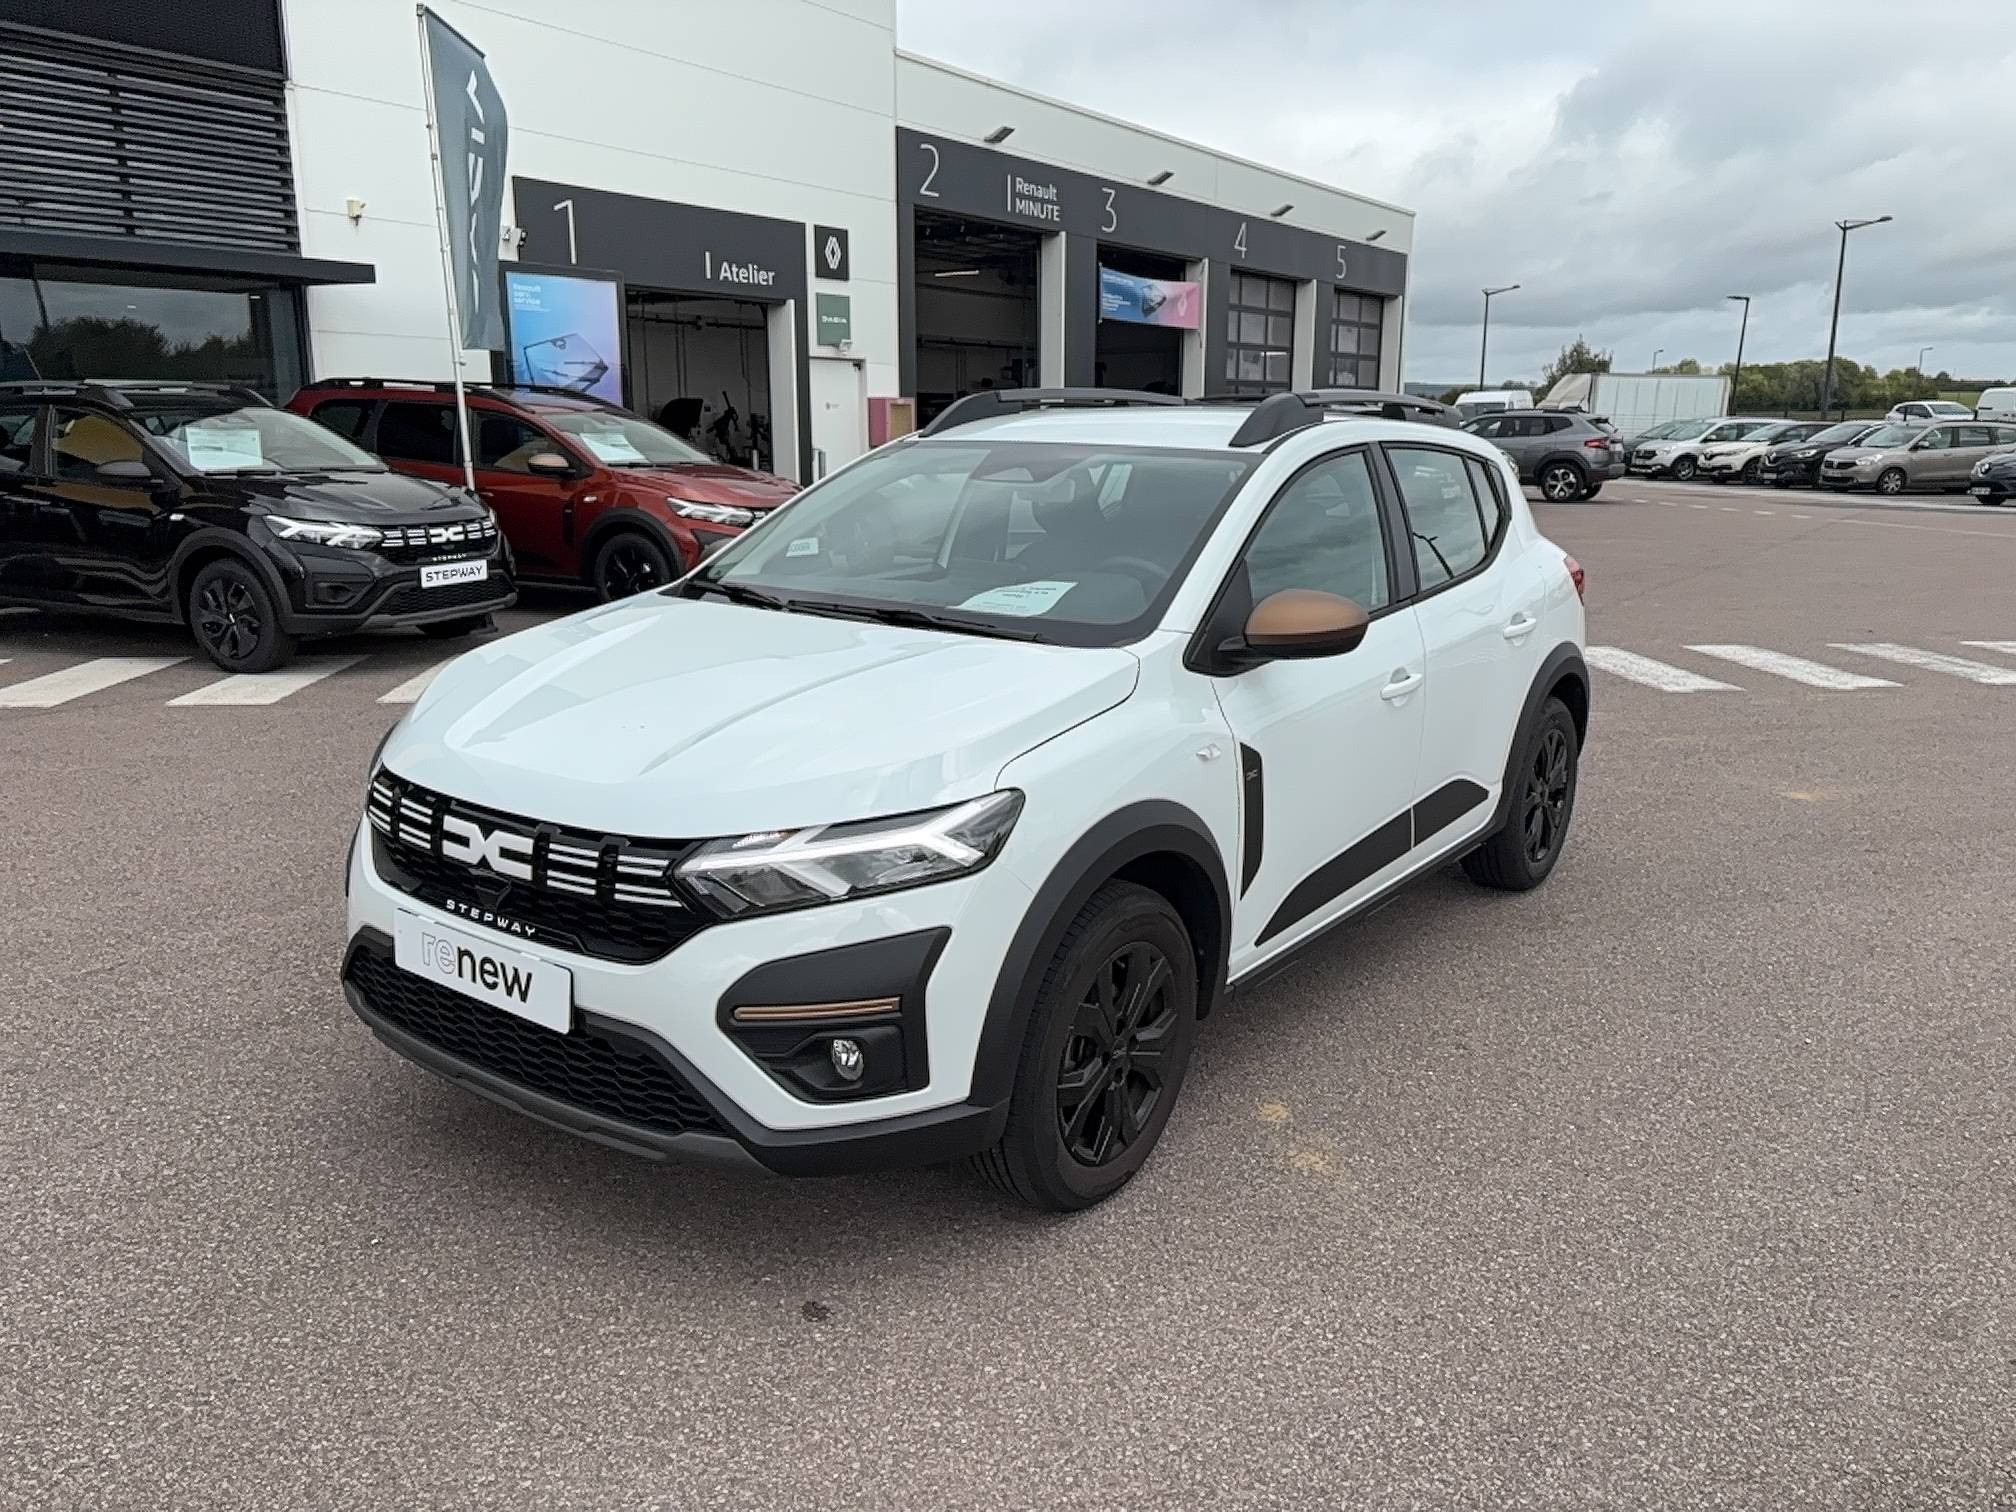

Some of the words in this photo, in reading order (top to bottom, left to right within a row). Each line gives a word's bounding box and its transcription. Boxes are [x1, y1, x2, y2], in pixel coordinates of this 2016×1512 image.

[919, 143, 940, 198] 2
[1014, 176, 1058, 201] Renault
[1015, 197, 1061, 222] MINUTE
[1101, 187, 1117, 233] 3
[553, 199, 578, 265] 1
[1234, 221, 1248, 260] 4
[718, 260, 776, 286] Atelier
[1335, 244, 1347, 279] 5
[425, 566, 483, 583] STEPWAY
[446, 899, 536, 937] STEPWAY
[421, 932, 533, 1004] renew
